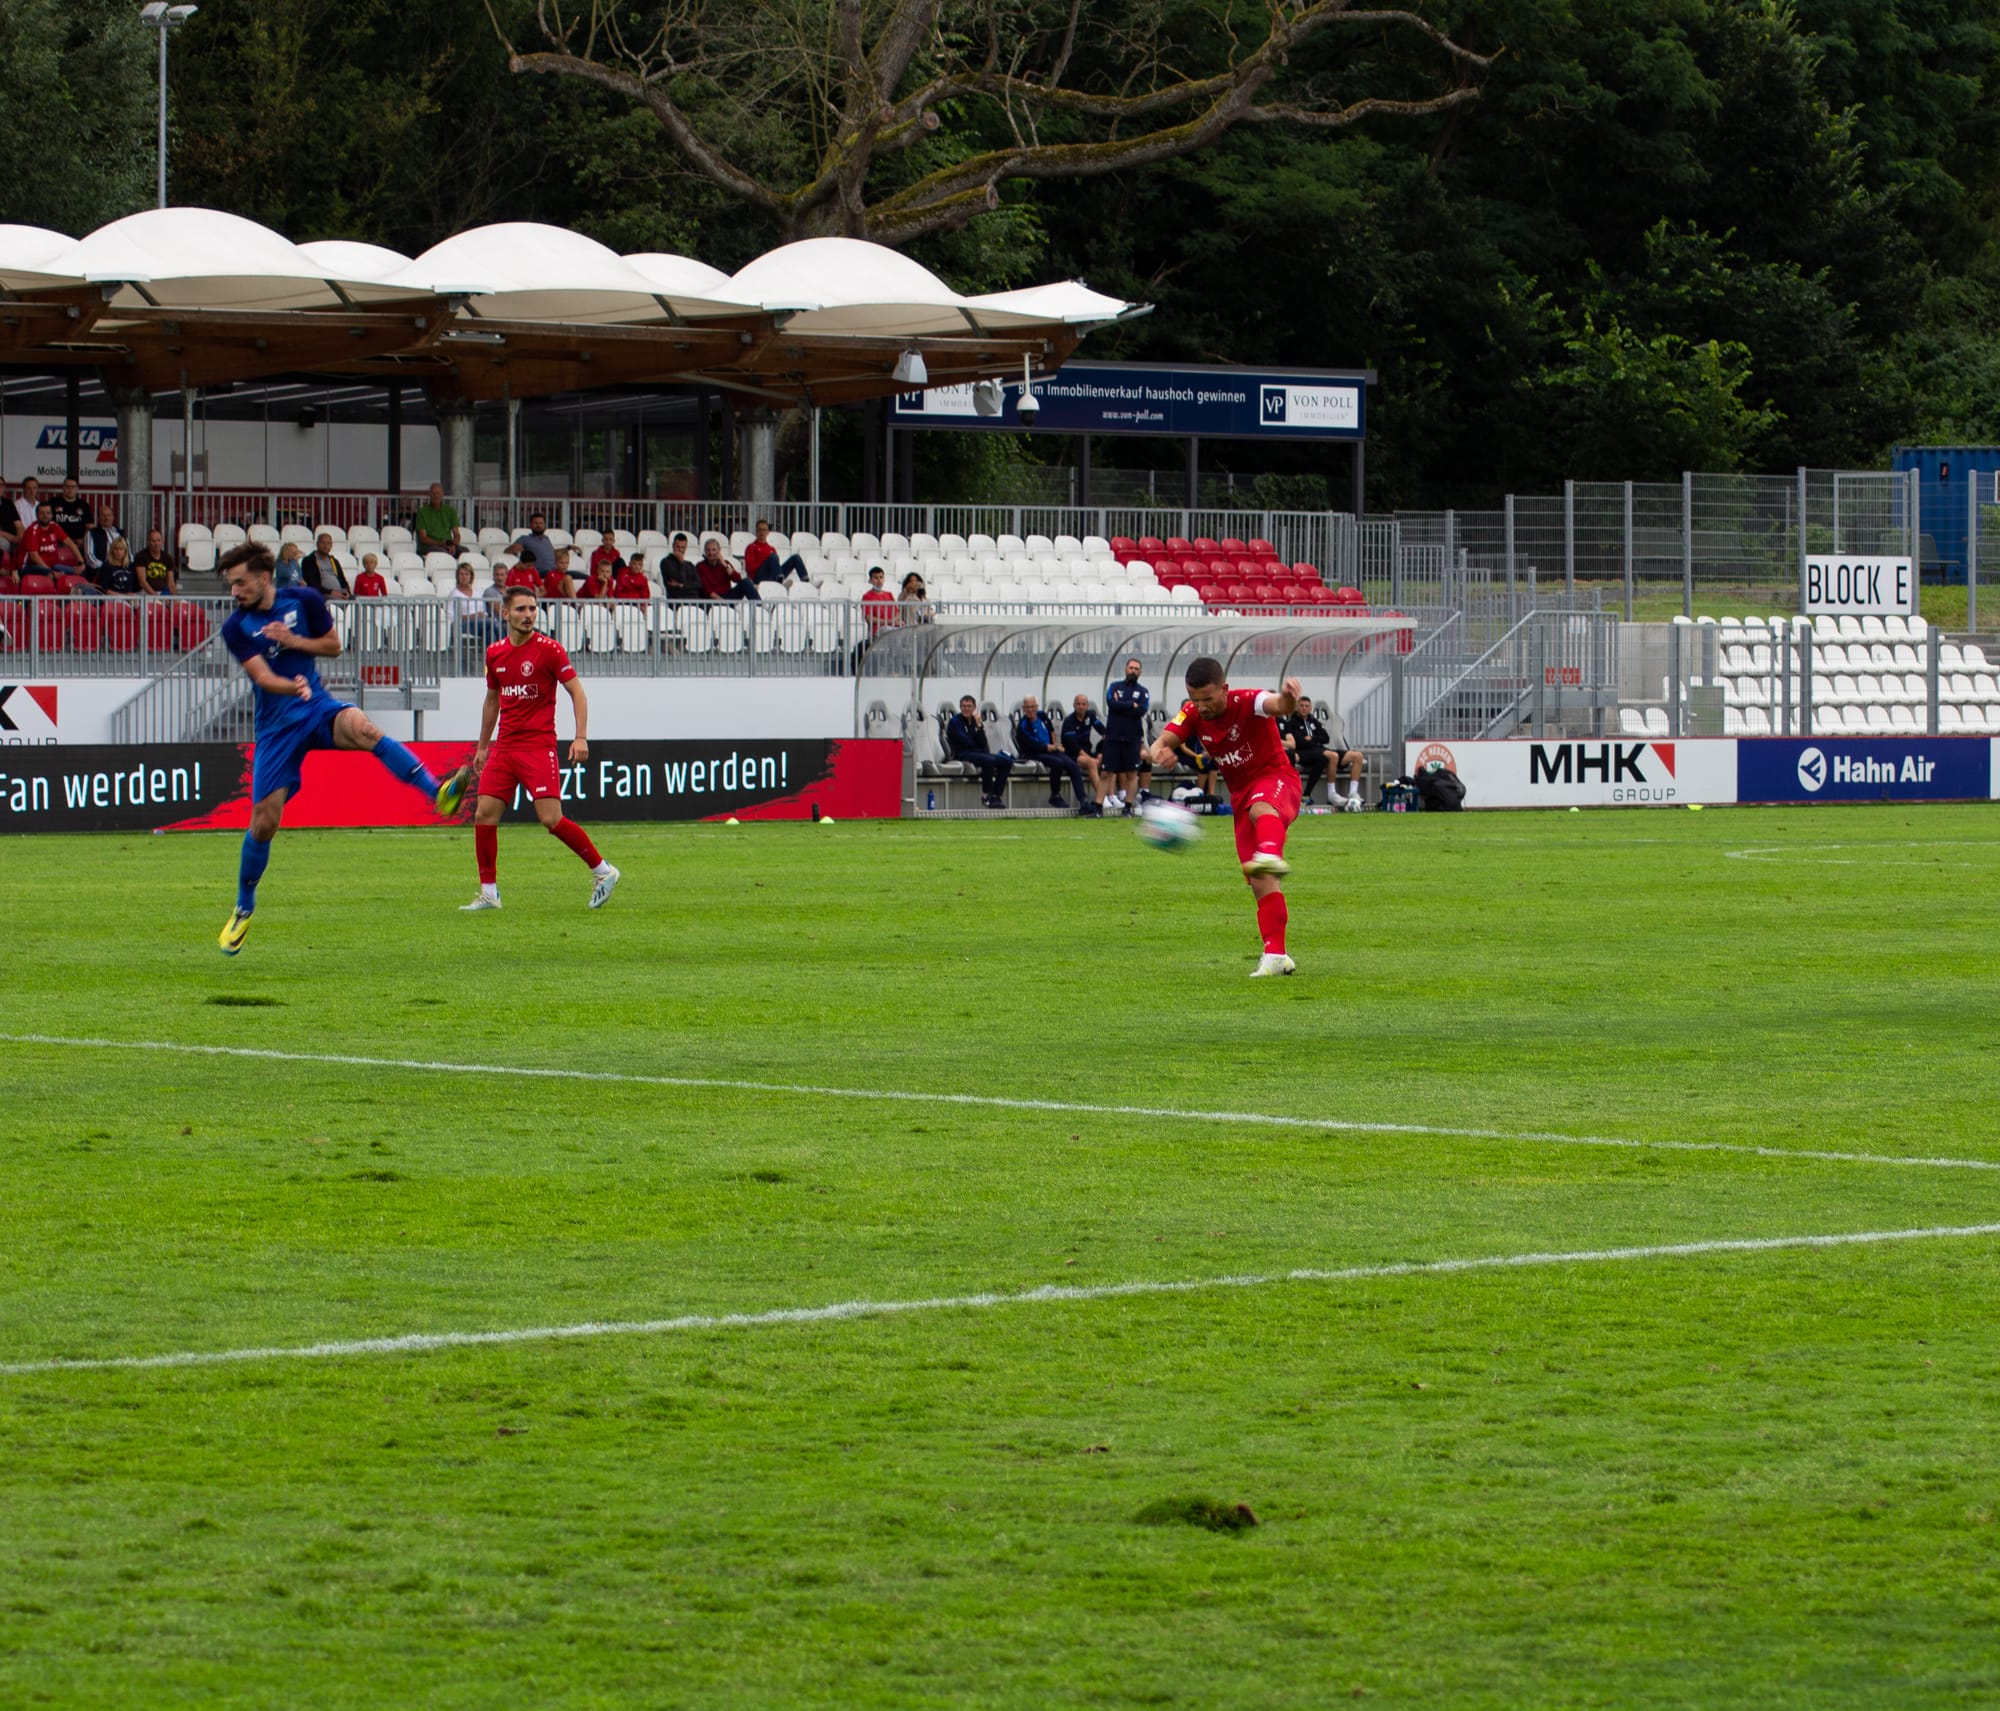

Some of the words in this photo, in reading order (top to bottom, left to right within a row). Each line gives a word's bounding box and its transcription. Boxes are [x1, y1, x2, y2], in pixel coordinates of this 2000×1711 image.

[1018, 383, 1043, 396] Bim
[1047, 383, 1143, 399] Immobilienverkauf
[1146, 387, 1194, 401] haushoch
[1197, 389, 1246, 404] gewinnen
[1265, 396, 1284, 414] VP
[1293, 395, 1319, 407] VON
[1323, 397, 1353, 409] POLL
[79, 466, 116, 477] elematik
[1808, 564, 1881, 605] BLOCK
[1896, 566, 1907, 605] E
[600, 760, 651, 798] Fan
[664, 751, 787, 794] werden!
[1530, 743, 1647, 784] MHK
[1833, 755, 1895, 783] Hahn
[1900, 755, 1936, 783] Air
[63, 761, 201, 809] werden!
[1613, 788, 1676, 801] GROUP
